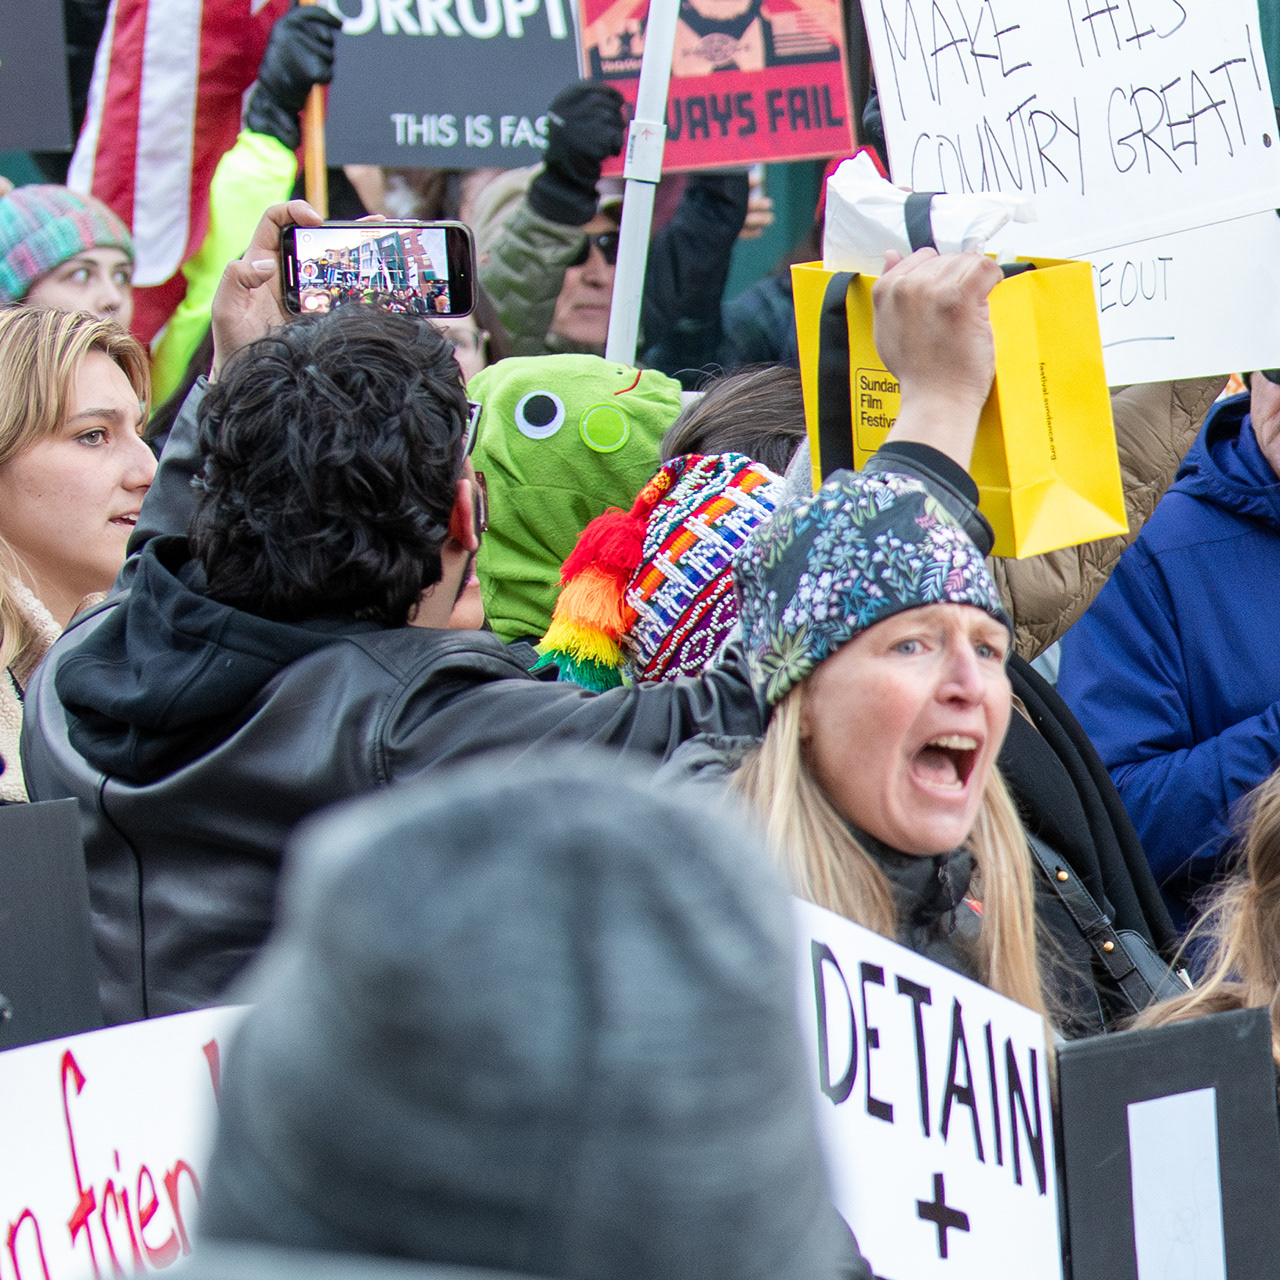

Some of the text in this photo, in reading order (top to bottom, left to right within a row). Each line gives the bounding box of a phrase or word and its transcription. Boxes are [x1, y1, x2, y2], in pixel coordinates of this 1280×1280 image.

[881, 0, 1032, 121] MAKE
[391, 113, 458, 147] THIS
[465, 114, 494, 148] IS
[765, 85, 843, 133] FAIL
[911, 24, 1272, 196] COUNTRY GREAT!
[860, 393, 883, 410] Film
[860, 411, 897, 429] Festiva
[1039, 361, 1057, 461] festival.sundance.org
[811, 938, 1048, 1197] DETAIN
